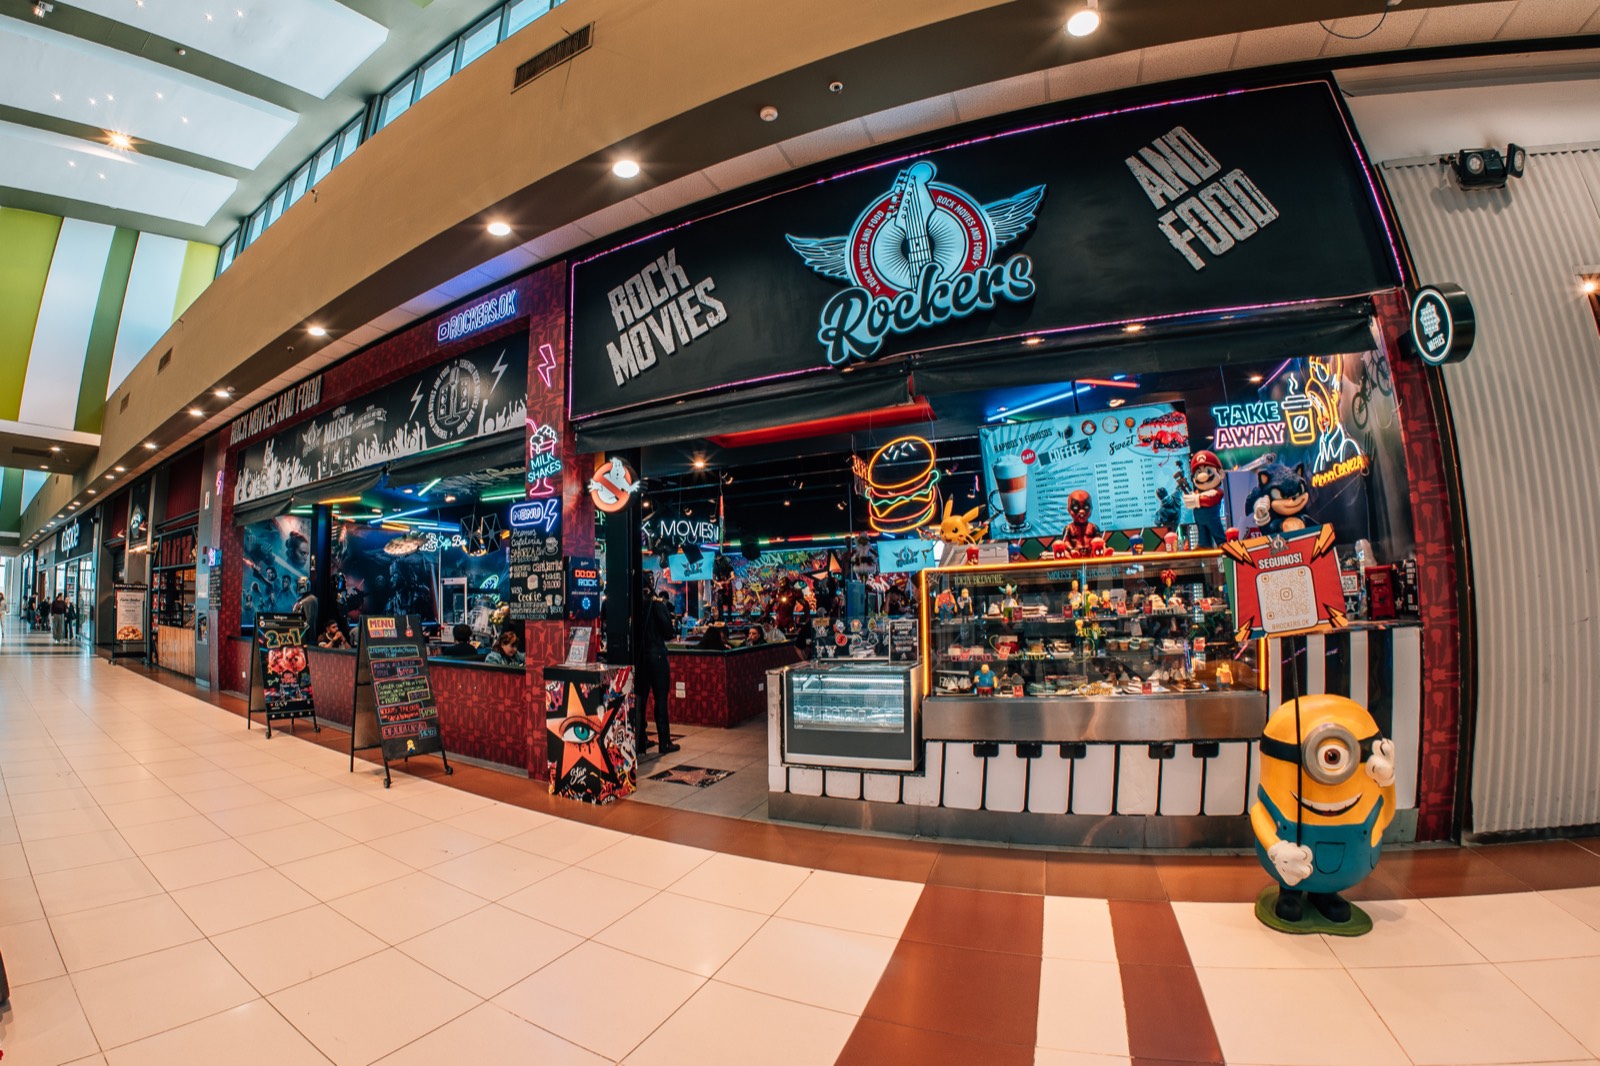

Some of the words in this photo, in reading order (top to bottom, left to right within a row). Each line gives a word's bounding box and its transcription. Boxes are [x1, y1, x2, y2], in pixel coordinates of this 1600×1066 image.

[1124, 125, 1222, 210] AND
[936, 194, 957, 210] ROCK
[867, 210, 885, 229] FOOD
[953, 205, 977, 227] MOVIES
[1157, 168, 1280, 271] FOOD
[861, 228, 873, 243] AND
[970, 226, 982, 244] AND
[858, 243, 870, 269] MOVIES
[973, 242, 983, 260] FOOD
[862, 270, 879, 288] ROCK
[606, 248, 690, 332] ROCK
[449, 289, 518, 339] ROCKERS.OK
[818, 254, 1037, 367] Rockers
[605, 277, 728, 387] MOVIES
[1427, 333, 1445, 352] WAFFLES
[229, 414, 249, 446] ROCK
[247, 398, 278, 437] MOVIES
[276, 387, 297, 423] AND
[296, 374, 322, 414] FOOD
[1212, 401, 1281, 426] TAKE
[323, 413, 354, 445] MUSIC
[1025, 428, 1053, 444] FURIOSOS
[1214, 422, 1287, 450] AWAY
[1050, 443, 1082, 462] COFFEE
[1109, 434, 1136, 456] Sweet
[529, 451, 556, 470] MILK
[527, 459, 563, 484] SHAKES
[512, 506, 541, 521] MENU
[660, 520, 713, 538] MOVIES
[1258, 552, 1303, 570] SEGUINOS!
[973, 573, 1004, 585] BROWNIE
[1047, 570, 1073, 581] MOUSSE
[369, 619, 394, 629] MENU
[569, 765, 587, 785] Star
